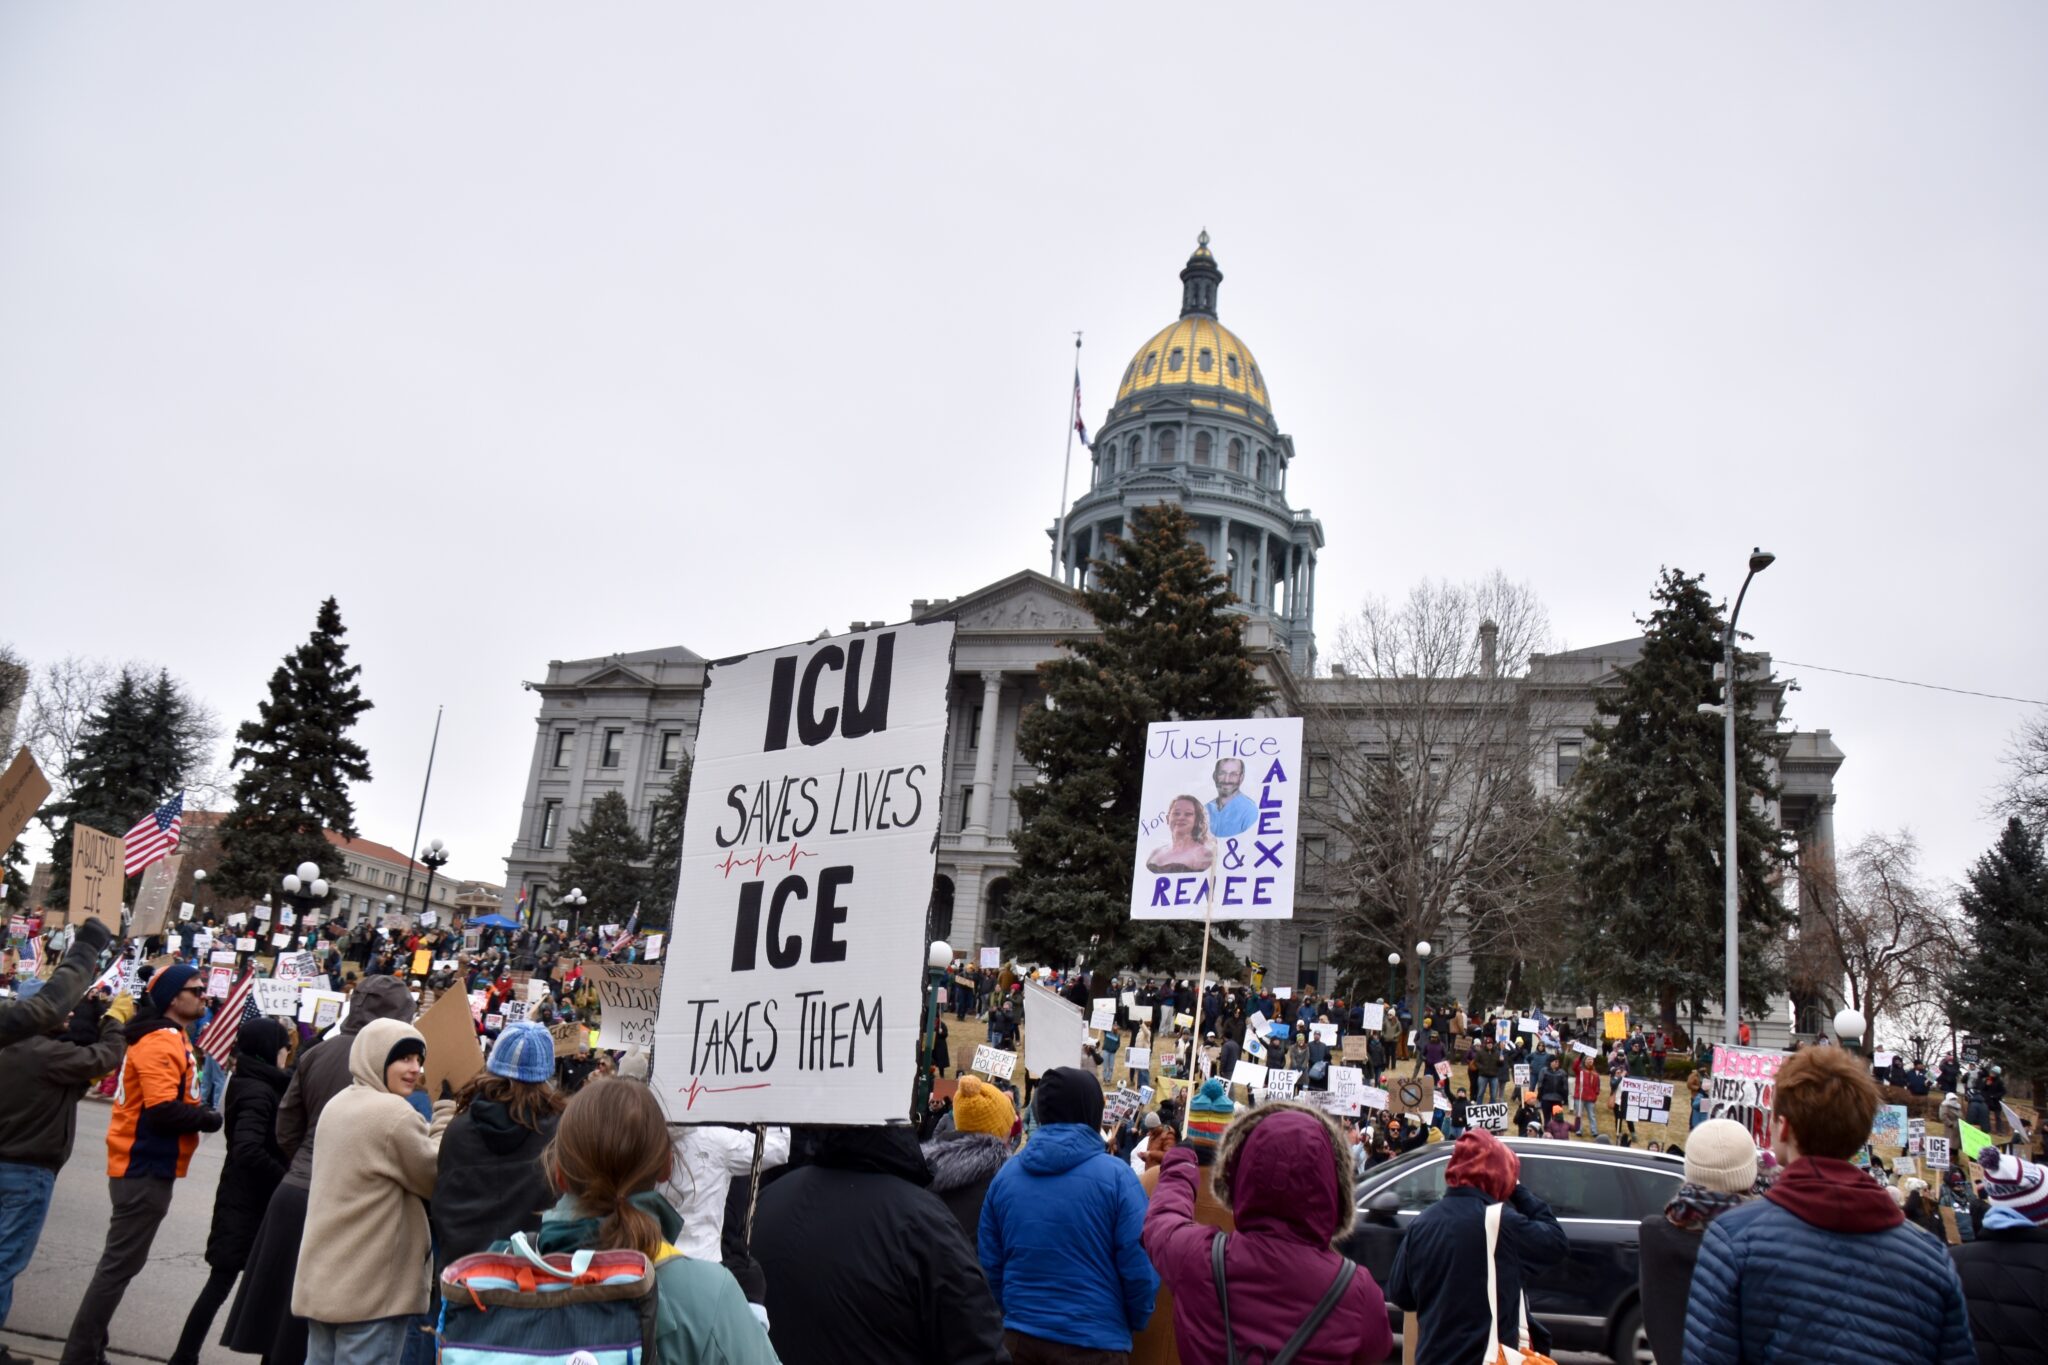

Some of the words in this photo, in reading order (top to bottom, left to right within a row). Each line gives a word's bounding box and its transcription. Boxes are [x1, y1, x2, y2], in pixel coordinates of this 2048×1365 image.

[764, 632, 896, 752] ICU
[1149, 730, 1280, 759] Justice
[716, 775, 818, 848] SAVES
[830, 765, 926, 834] LIVES
[1254, 758, 1287, 868] ALEX
[1141, 812, 1167, 836] for
[75, 830, 116, 877] ABOLISH
[1223, 838, 1245, 870] &
[84, 875, 102, 914] ICE
[731, 865, 854, 972] ICE
[265, 999, 289, 1009] ICE
[511, 1002, 525, 1014] ICE
[688, 999, 778, 1076] TAKES
[795, 990, 884, 1073] THEM
[975, 1057, 1012, 1078] POLICE!
[977, 1047, 990, 1058] NO
[990, 1050, 1016, 1067] SECRET
[1272, 1071, 1293, 1082] ICE
[1336, 1070, 1352, 1080] ALEX
[1269, 1092, 1292, 1101] NOW
[1270, 1082, 1293, 1091] OUT
[1713, 1078, 1746, 1102] NEEDS
[1468, 1104, 1508, 1119] DEFUND
[1477, 1118, 1501, 1130] ICE
[1930, 1139, 1946, 1152] ICE
